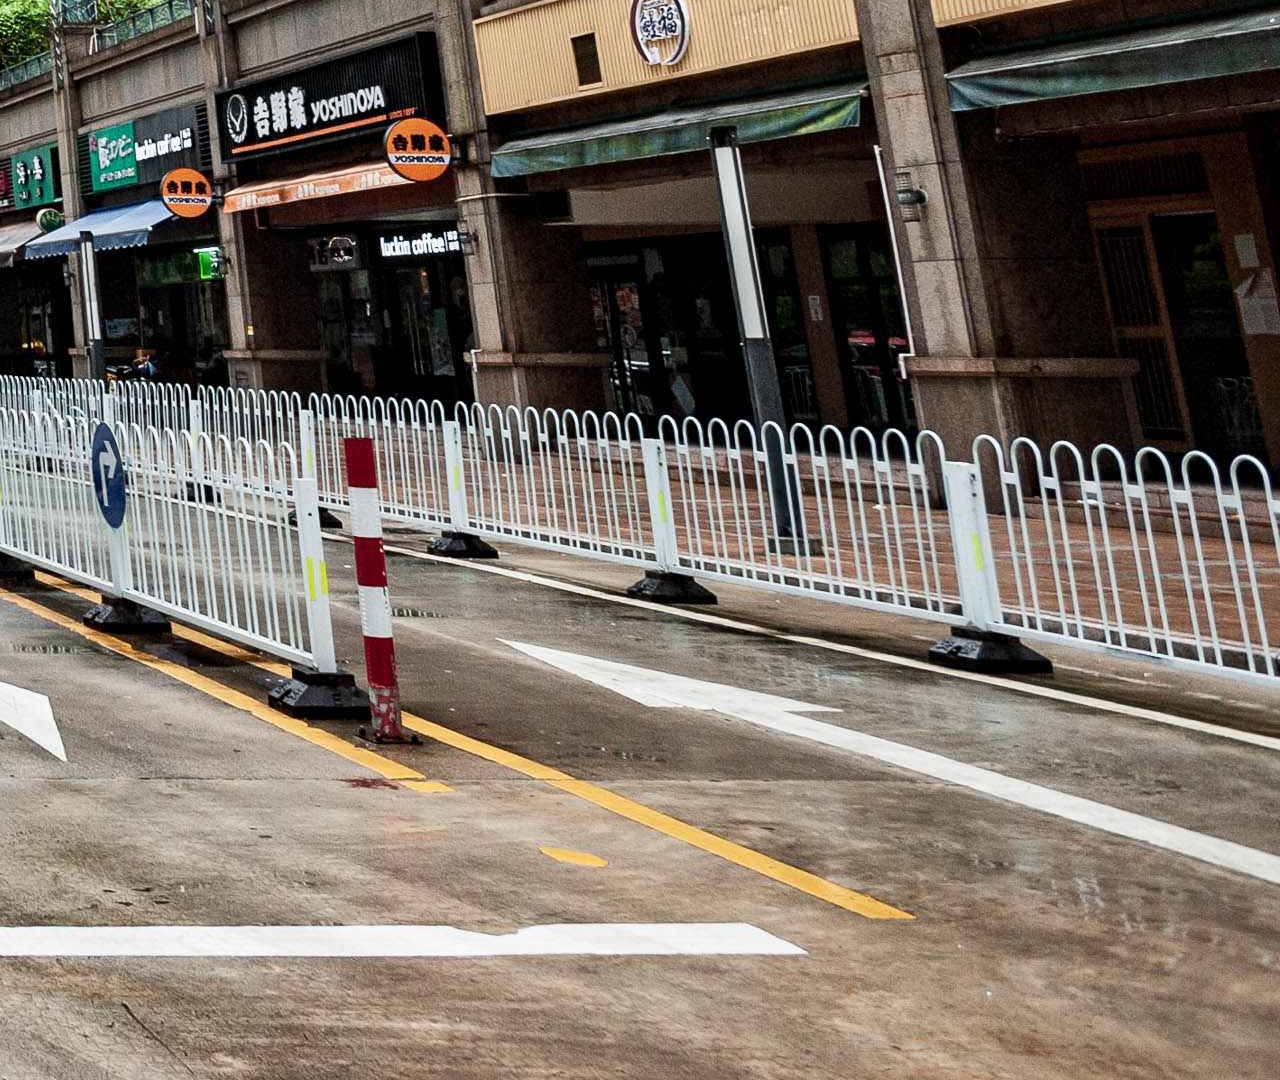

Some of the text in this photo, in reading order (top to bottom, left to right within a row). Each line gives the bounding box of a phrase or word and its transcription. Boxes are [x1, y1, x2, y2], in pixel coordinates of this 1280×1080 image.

[253, 85, 386, 139] 吉野家 YOSHINOYA
[392, 133, 445, 152] 吉野家
[393, 154, 445, 164] YOSHINOYA
[380, 235, 411, 256] luckin
[412, 232, 445, 255] coffee
